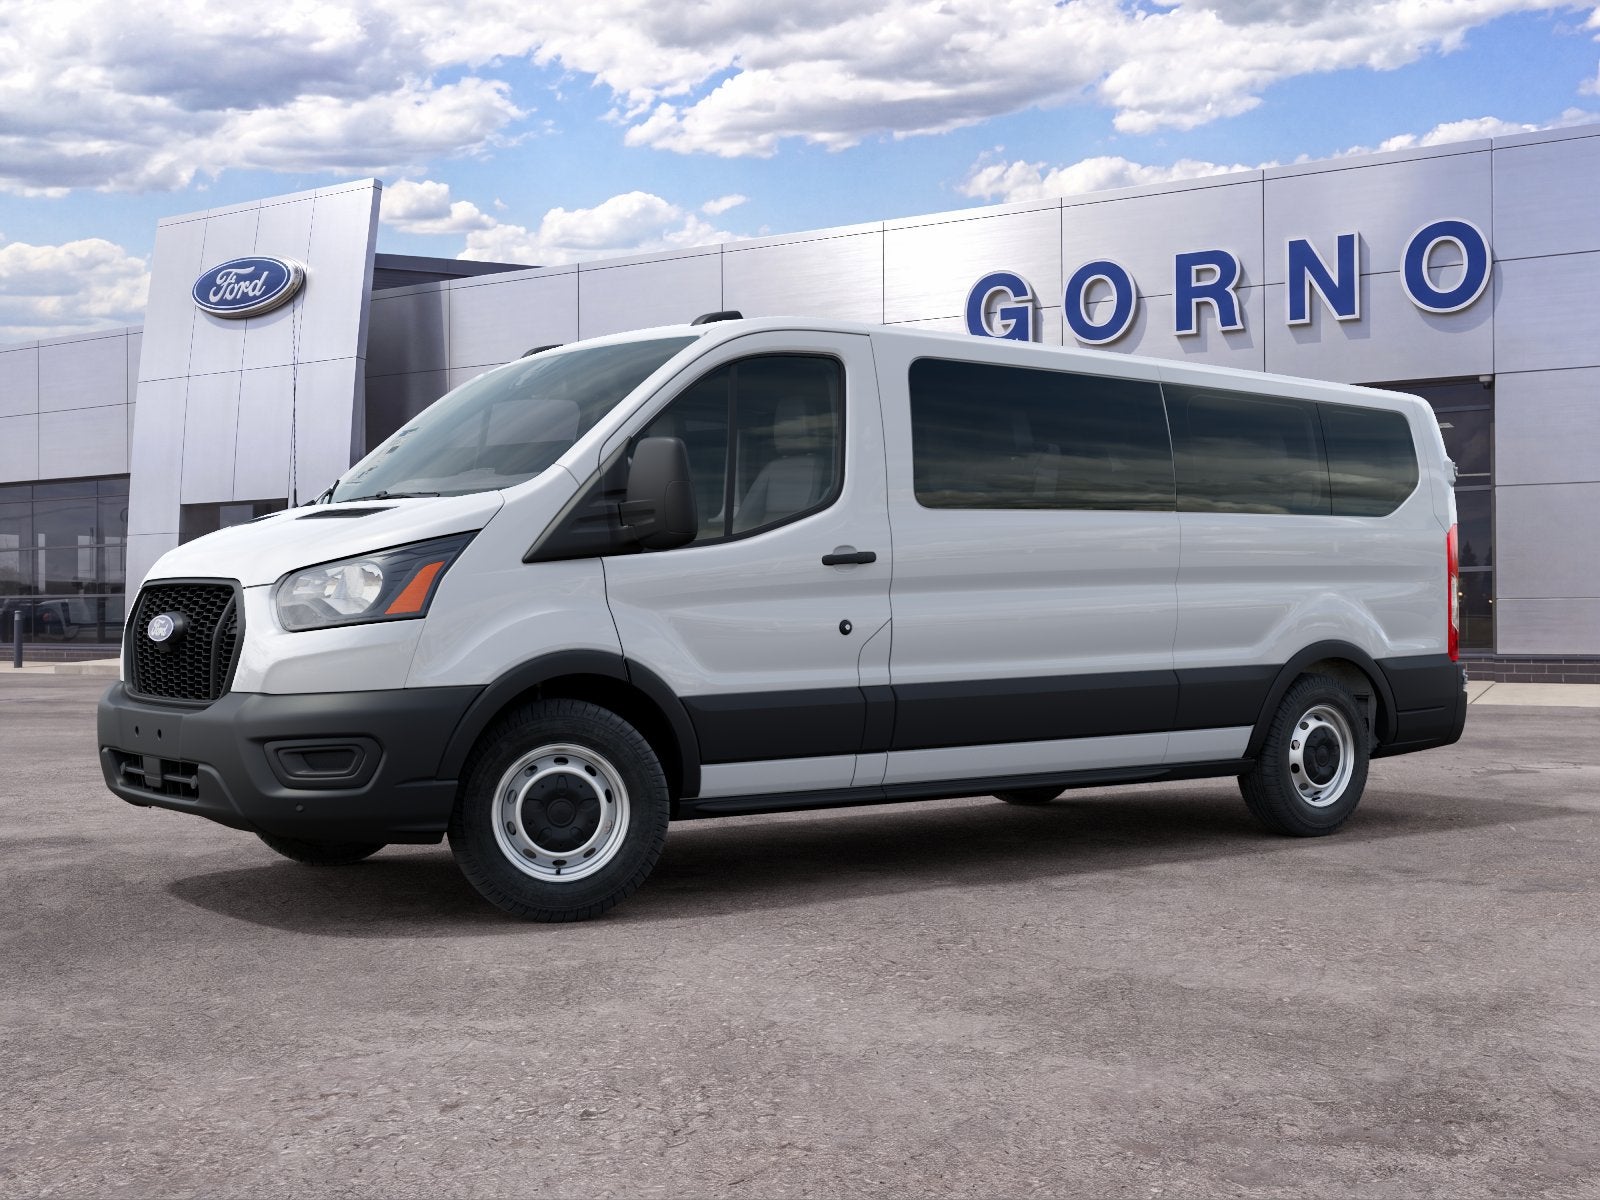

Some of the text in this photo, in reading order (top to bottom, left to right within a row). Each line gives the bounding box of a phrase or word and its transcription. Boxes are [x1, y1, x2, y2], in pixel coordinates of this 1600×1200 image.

[208, 266, 269, 303] Ford
[964, 217, 1493, 344] GORNO
[151, 619, 169, 637] Ford
